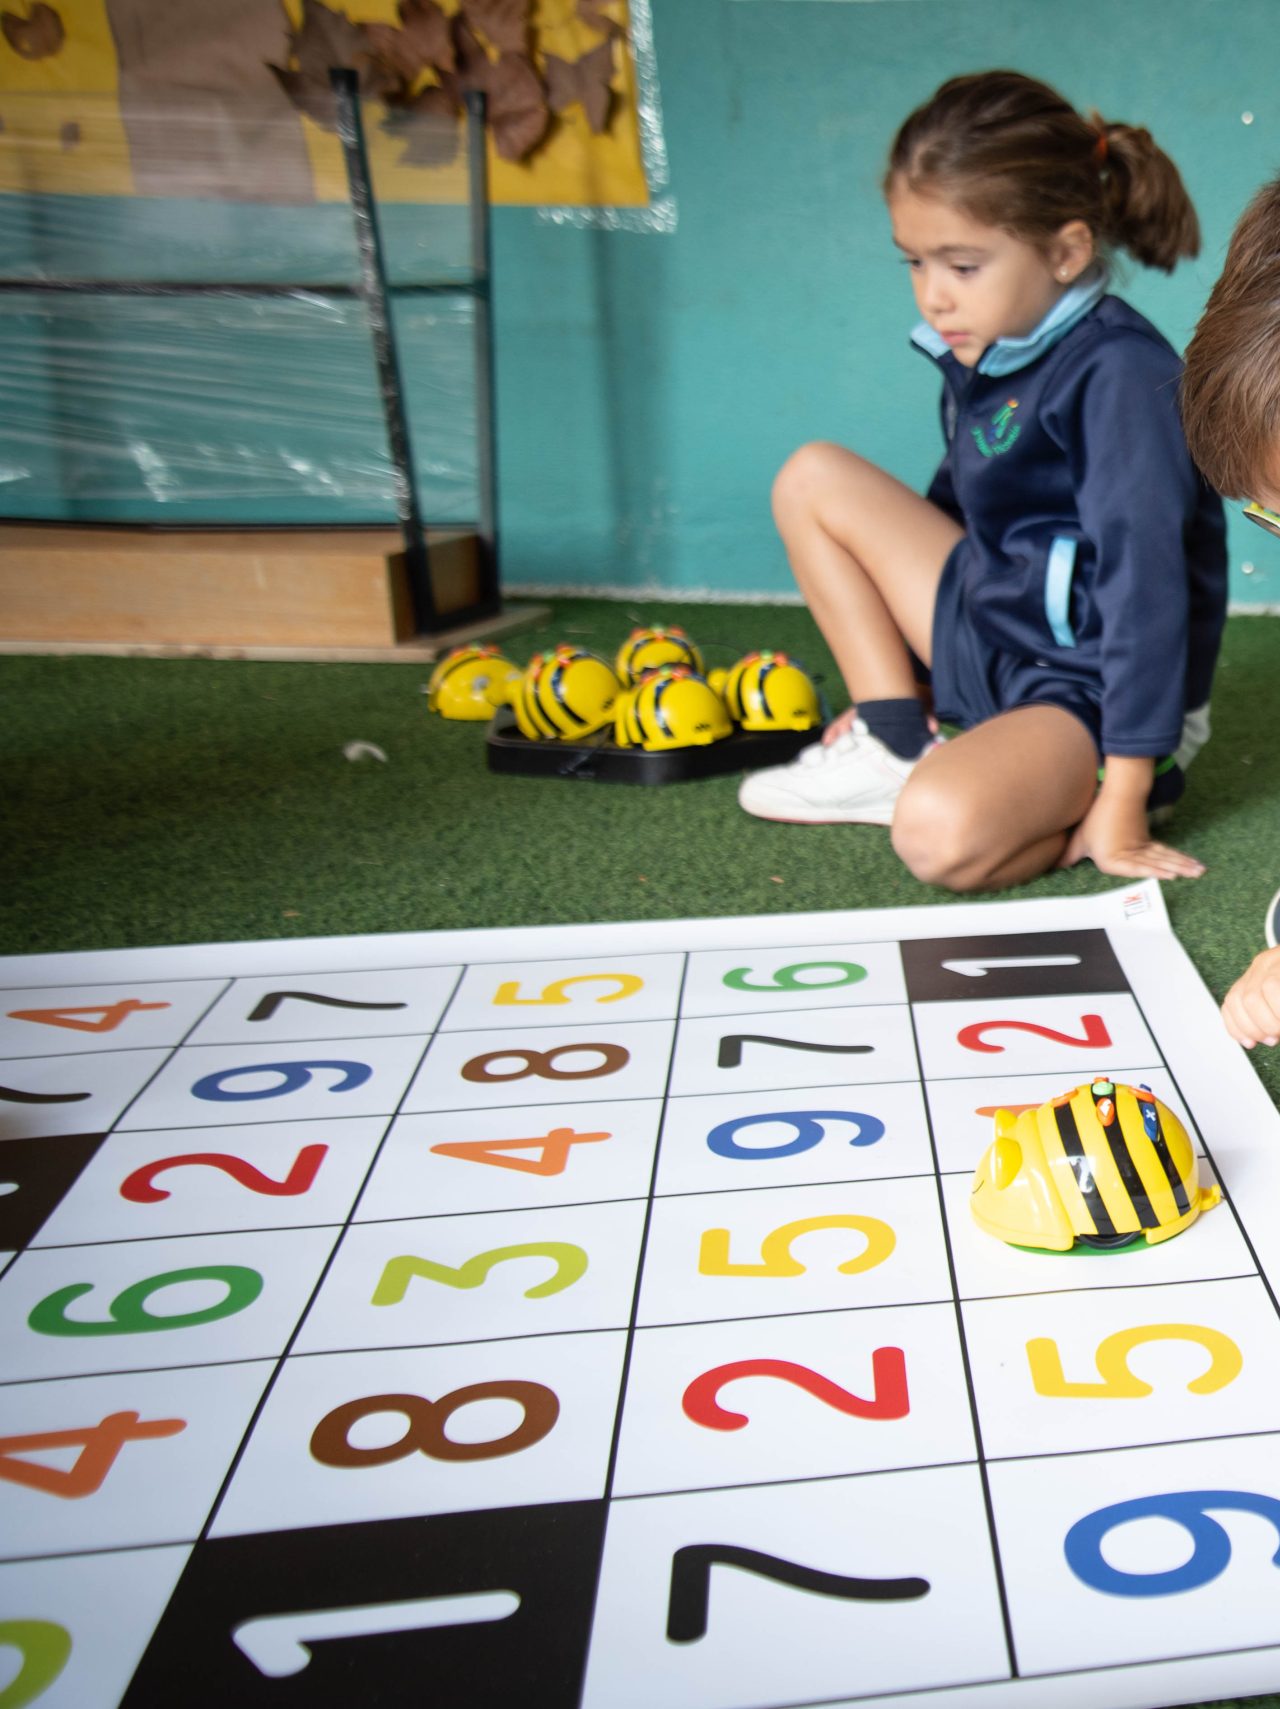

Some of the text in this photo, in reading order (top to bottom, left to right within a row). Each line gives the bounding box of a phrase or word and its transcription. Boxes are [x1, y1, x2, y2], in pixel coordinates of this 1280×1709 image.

[493, 974, 643, 1005] 5
[721, 960, 869, 992] 6
[942, 956, 1080, 976] 1
[9, 1000, 167, 1032] 4
[248, 992, 406, 1021] 7
[718, 1035, 873, 1067] 7
[957, 1015, 1112, 1053] 2
[192, 1061, 371, 1101] 9
[462, 1044, 627, 1082] 8
[430, 1128, 609, 1176] 4
[707, 1111, 884, 1159] 9
[120, 1144, 328, 1203] 2
[698, 1215, 896, 1277] 5
[372, 1243, 587, 1305] 3
[28, 1266, 262, 1335] 6
[1026, 1324, 1242, 1398] 5
[682, 1347, 910, 1431] 2
[310, 1381, 559, 1467] 8
[0, 1412, 185, 1497] 4
[667, 1544, 930, 1643] 7
[231, 1588, 521, 1678] 1
